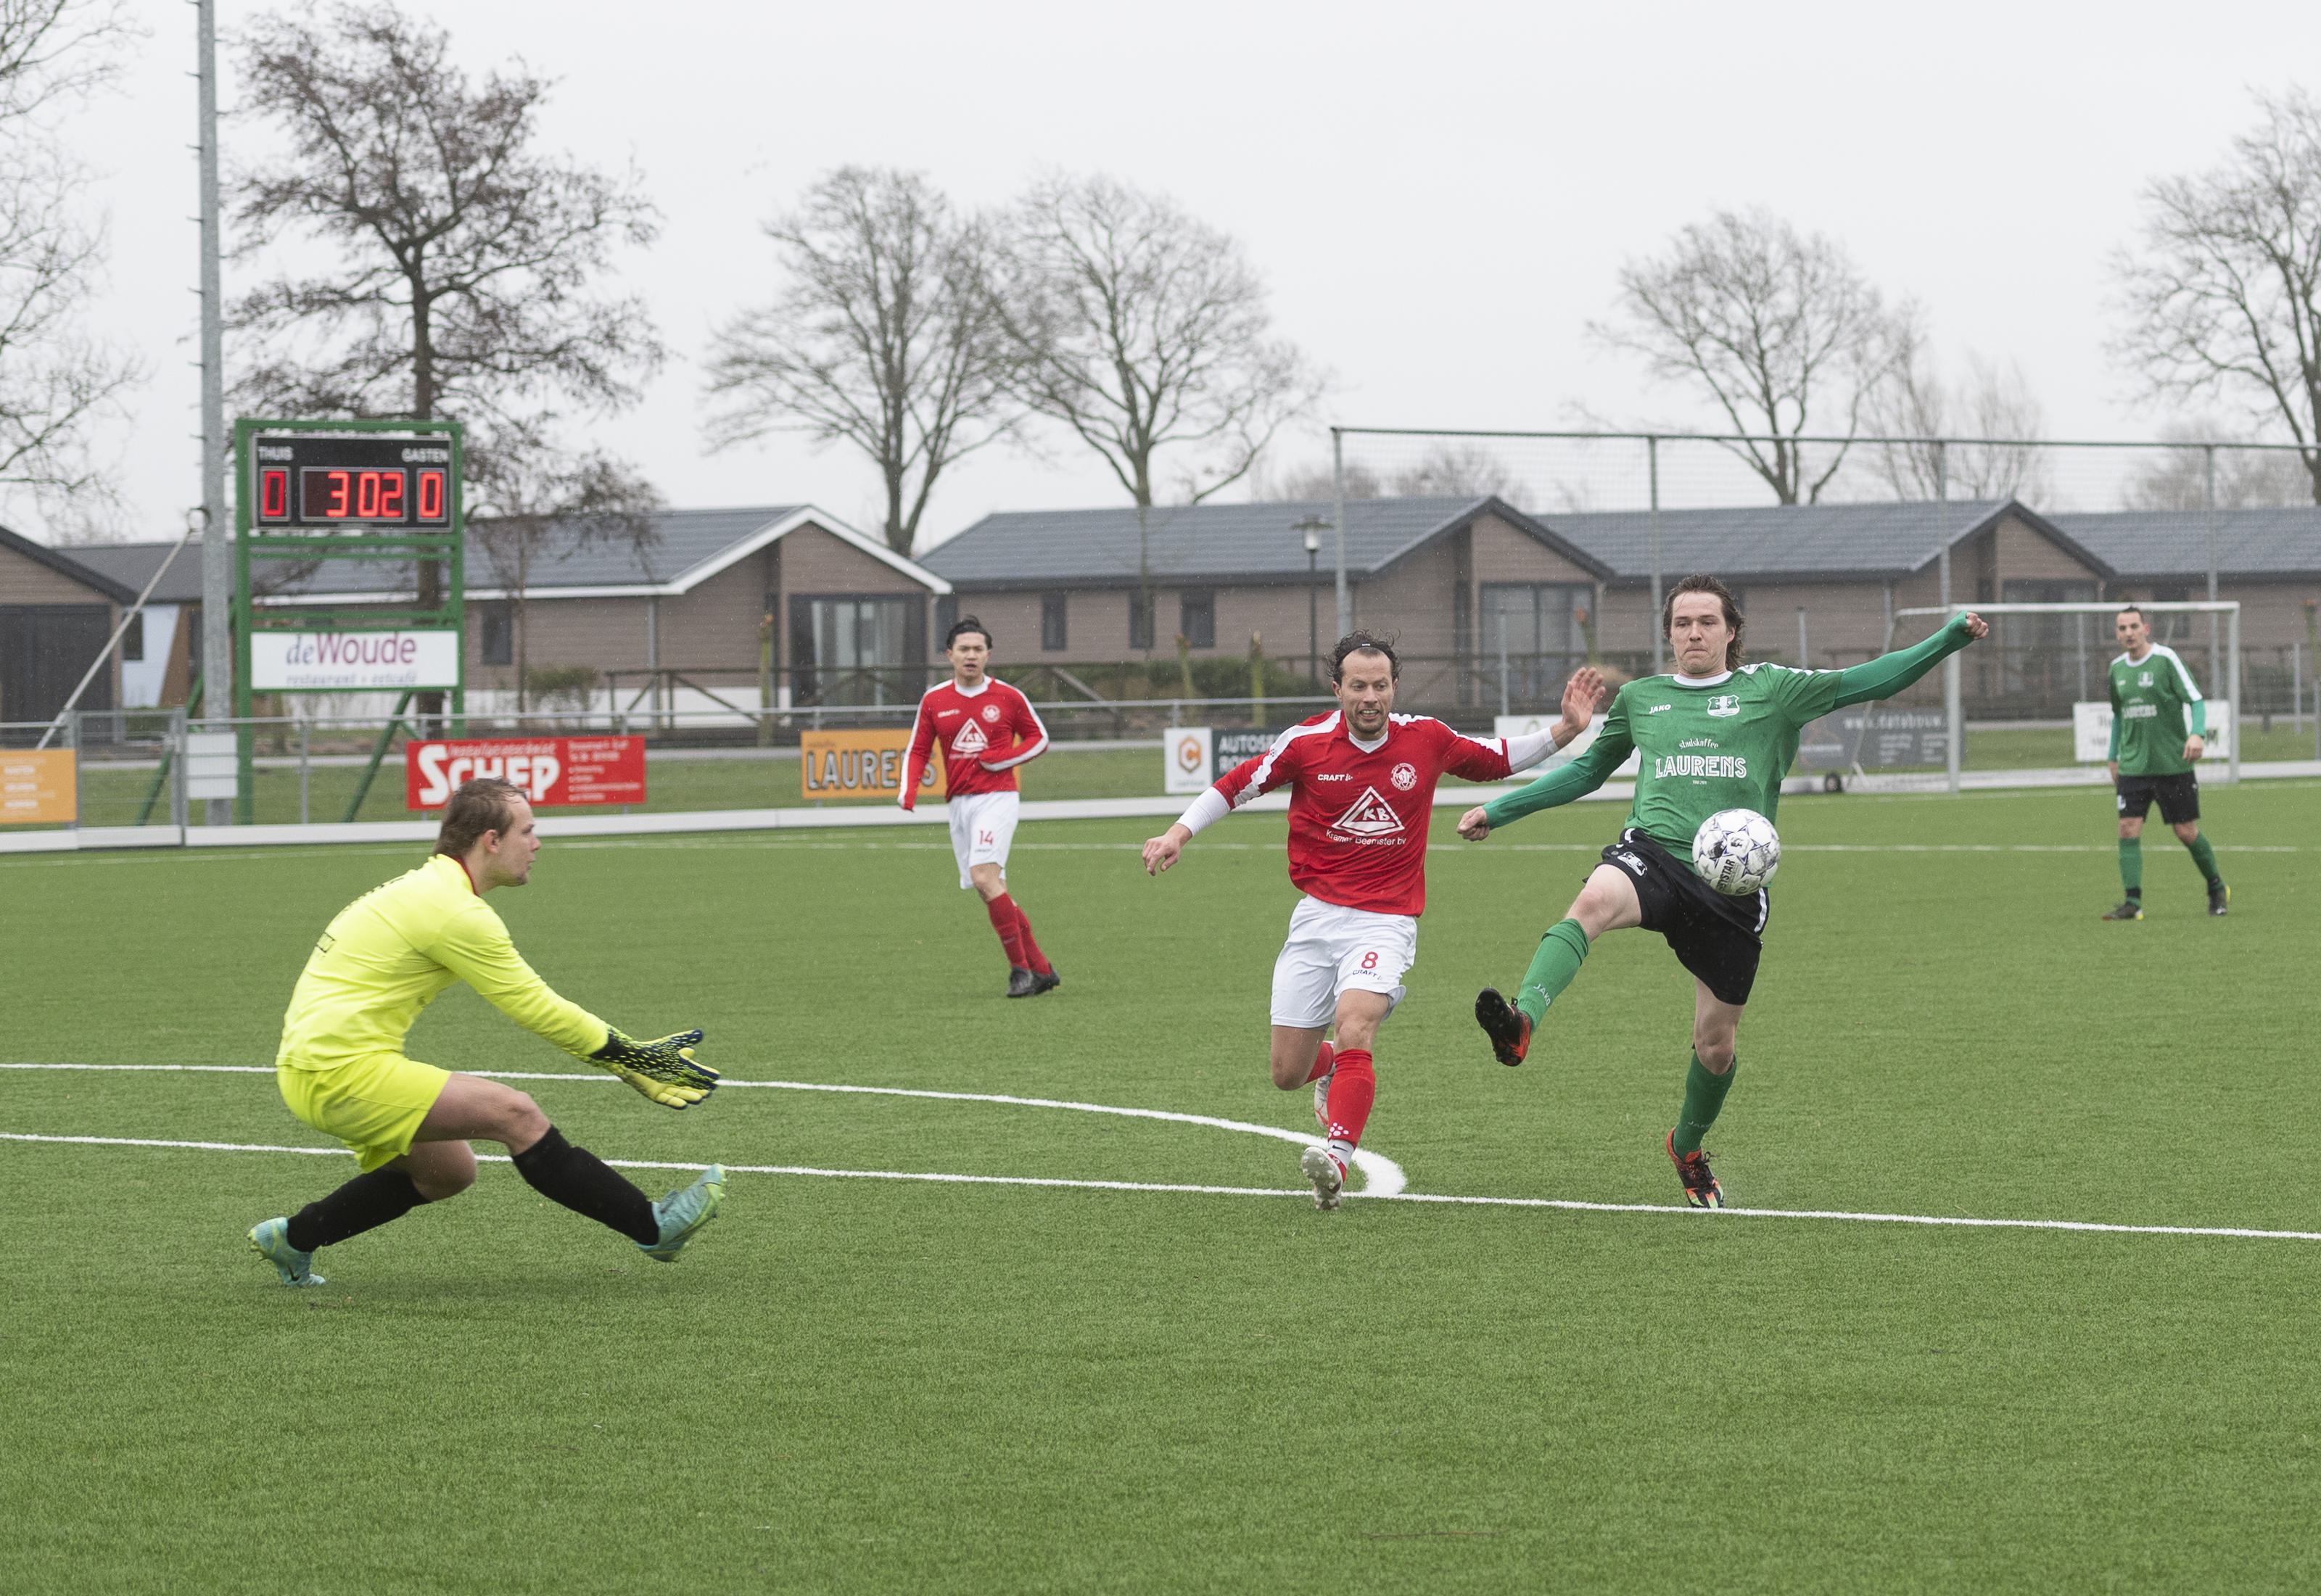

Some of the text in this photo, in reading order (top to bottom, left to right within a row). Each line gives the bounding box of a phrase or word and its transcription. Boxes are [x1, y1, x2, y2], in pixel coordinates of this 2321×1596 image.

[263, 470, 285, 517] 0
[419, 471, 442, 518] 0
[1649, 703, 1672, 714] JAKO
[1678, 737, 1719, 750] stadskaffee
[1654, 755, 1747, 779] LAURENS
[1317, 773, 1345, 782] CRAFT
[1363, 807, 1391, 822] KB
[979, 830, 994, 845] 14
[1326, 829, 1406, 845] Kramer Beemster bv
[1361, 951, 1379, 969] 8
[1533, 983, 1551, 1007] JAKO
